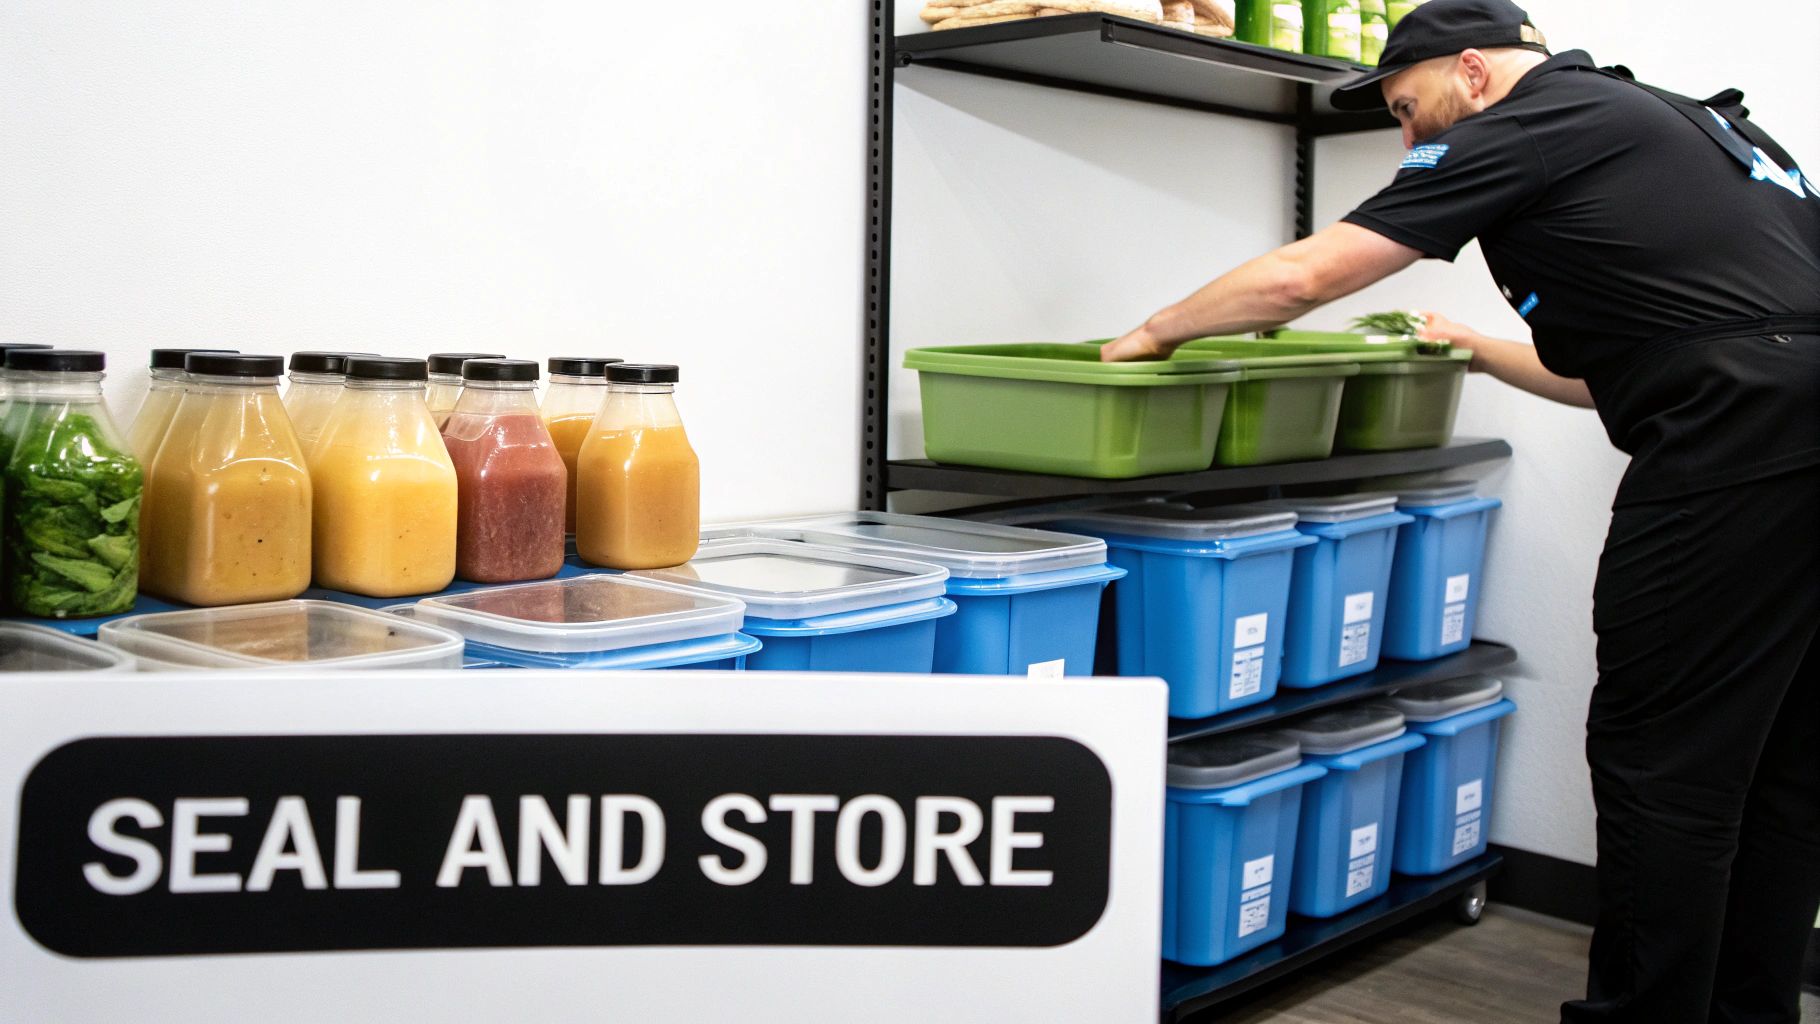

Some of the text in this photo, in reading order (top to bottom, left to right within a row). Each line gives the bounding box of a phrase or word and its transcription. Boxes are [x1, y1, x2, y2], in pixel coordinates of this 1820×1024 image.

[84, 793, 1055, 895] SEAL AND STORE
